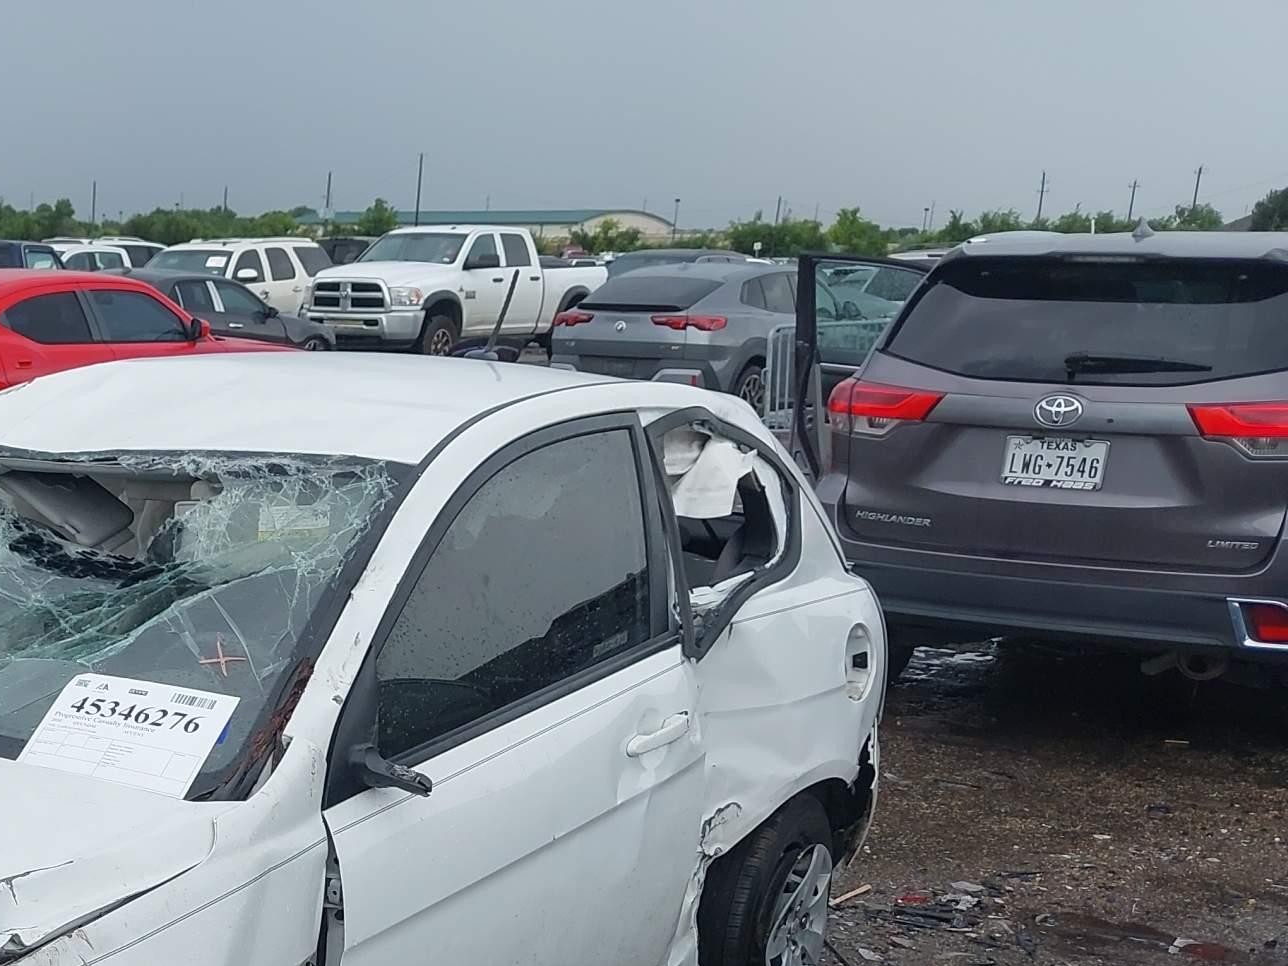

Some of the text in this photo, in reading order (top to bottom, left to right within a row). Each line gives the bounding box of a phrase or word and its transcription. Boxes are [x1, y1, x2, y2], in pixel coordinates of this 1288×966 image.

[1040, 440, 1077, 451] TEXAS
[1009, 452, 1100, 478] LWG 7546
[855, 510, 932, 527] HIGHLANDER
[1207, 540, 1260, 550] LIMITED
[70, 696, 208, 734] 45346276
